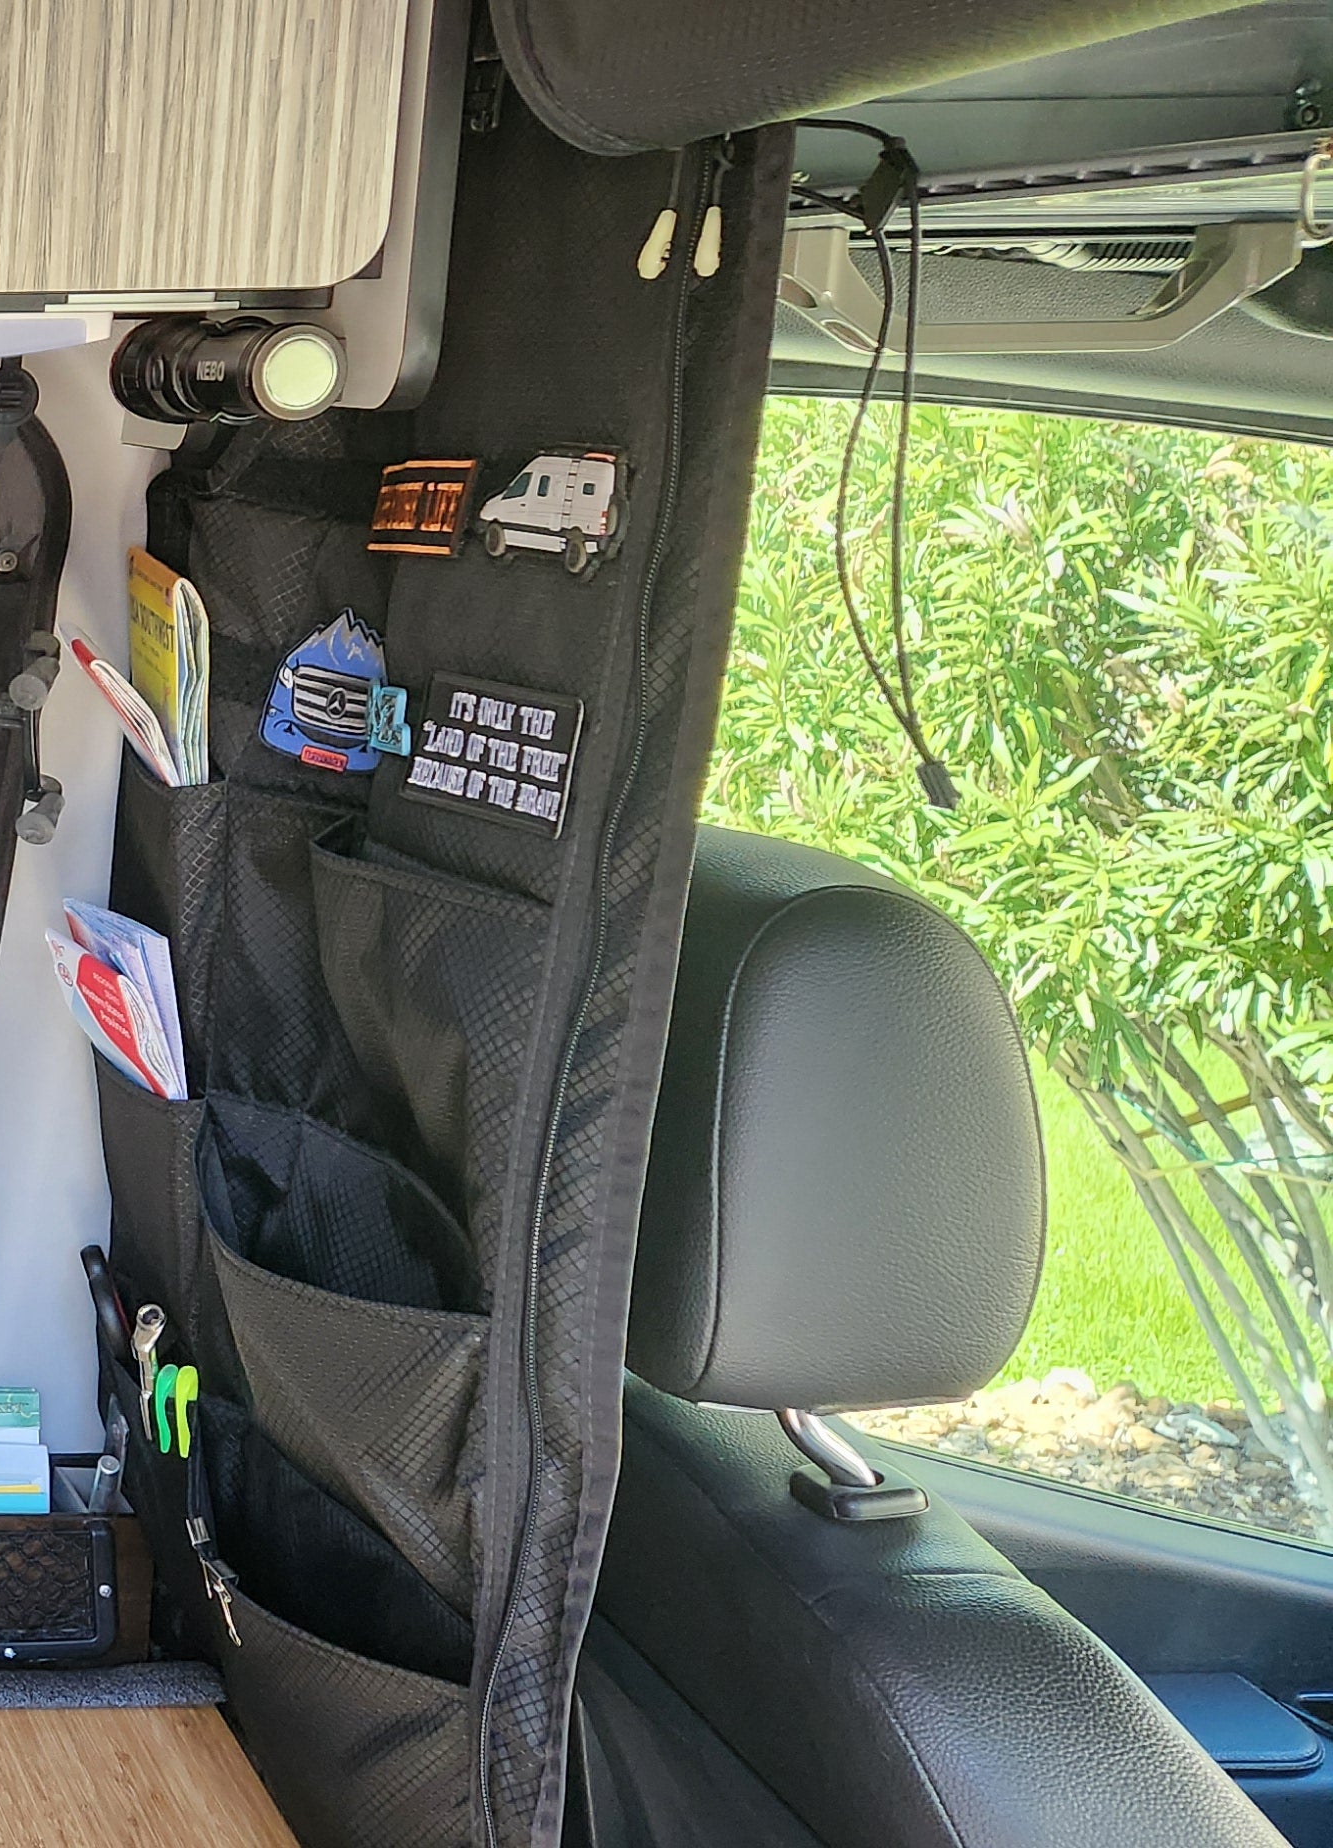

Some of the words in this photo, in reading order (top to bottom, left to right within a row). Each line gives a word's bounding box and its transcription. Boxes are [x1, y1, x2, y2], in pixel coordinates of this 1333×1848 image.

[196, 360, 225, 381] NEBO
[519, 705, 557, 740] THE
[465, 732, 487, 762] OF
[487, 737, 520, 772] THE
[407, 756, 468, 796] BECAUSE
[466, 769, 487, 800] OF
[487, 775, 518, 810] THE
[514, 782, 562, 822] BRAVE
